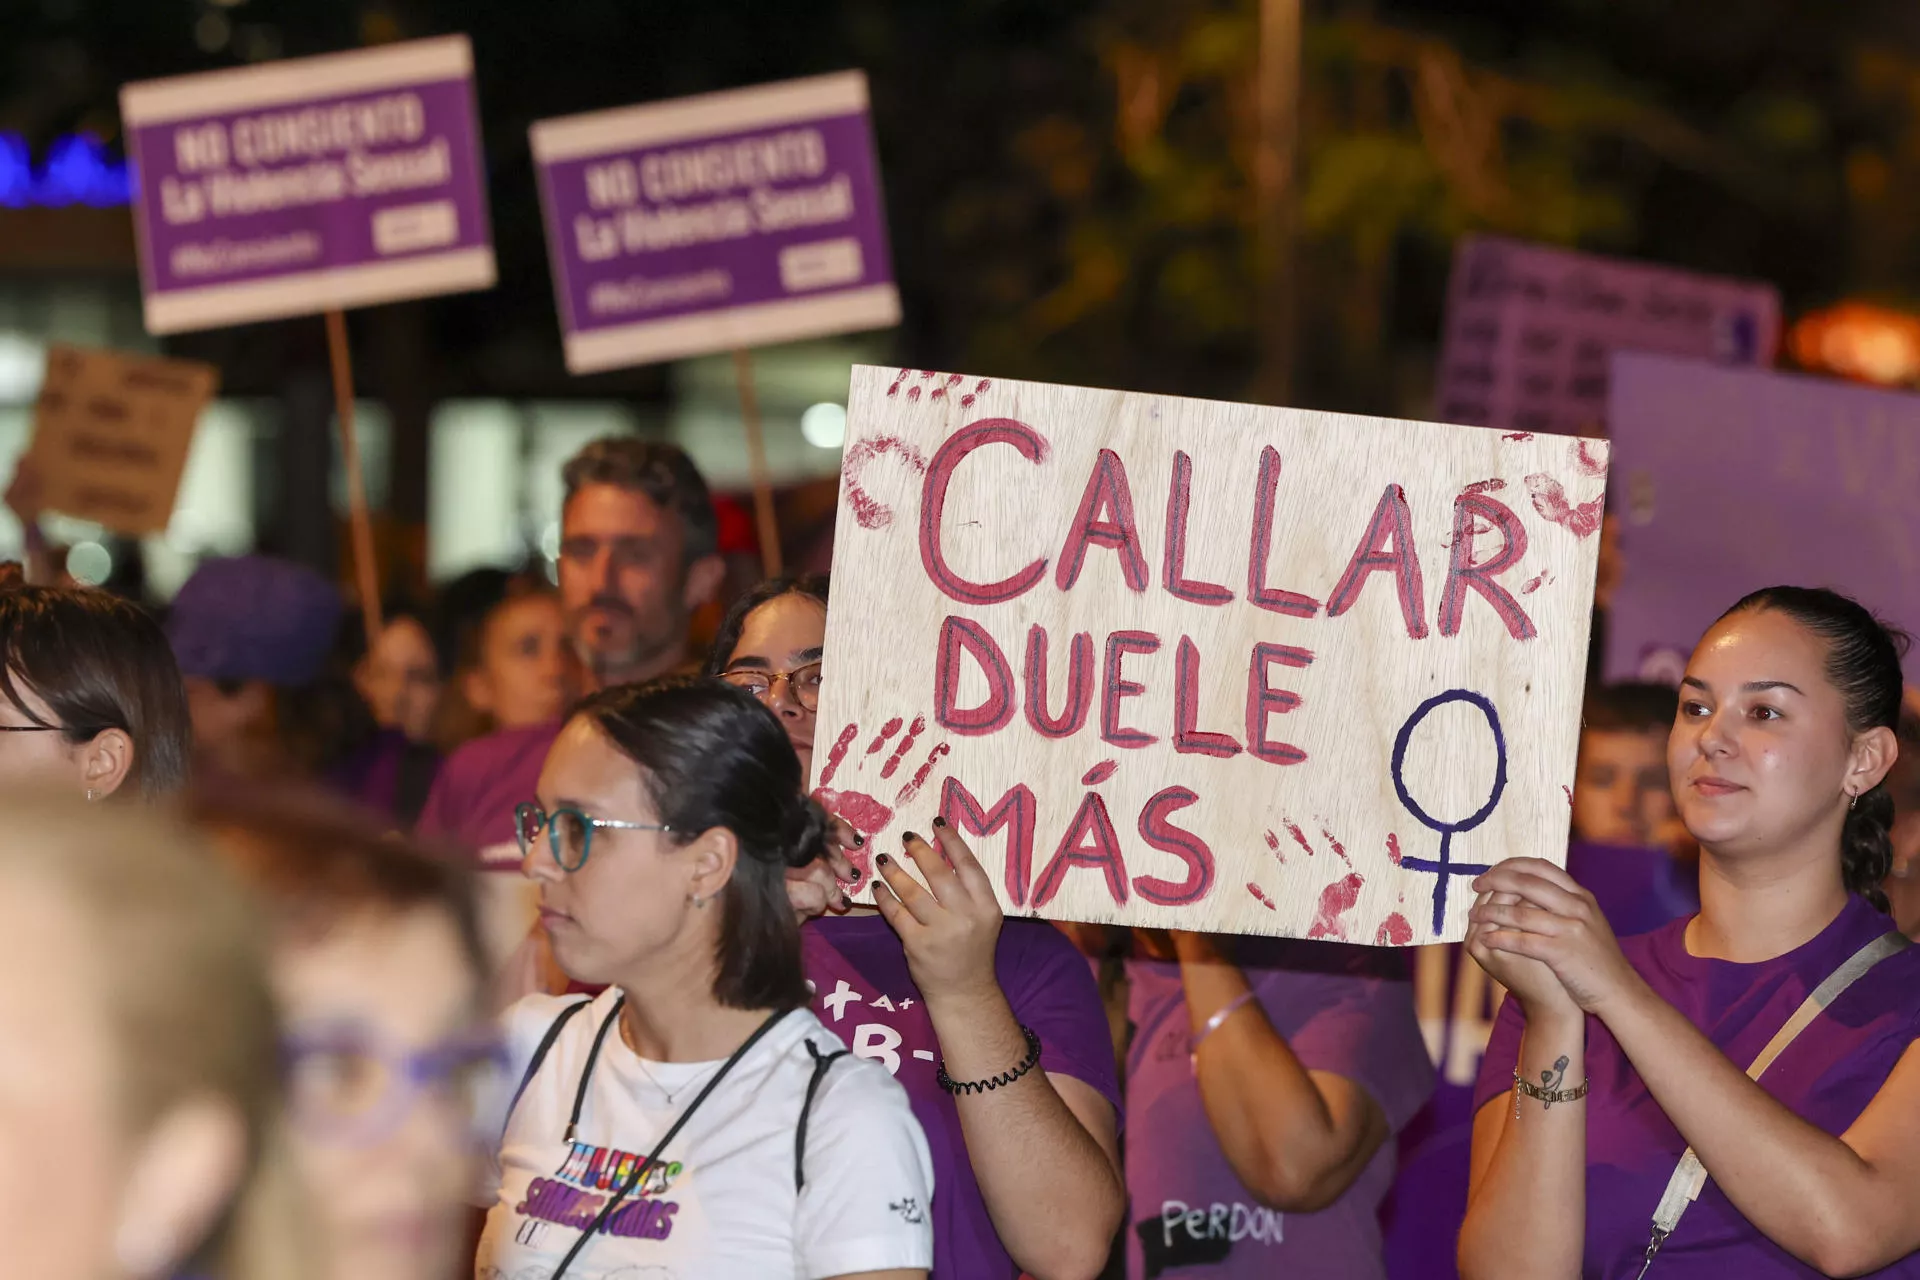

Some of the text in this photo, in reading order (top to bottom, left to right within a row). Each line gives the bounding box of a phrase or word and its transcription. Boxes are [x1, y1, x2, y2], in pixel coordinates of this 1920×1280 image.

[175, 122, 230, 174] NO
[585, 158, 639, 209] NO
[919, 417, 1539, 641] CALLAR
[934, 615, 1317, 766] DUELE
[932, 758, 1216, 908] MÁS
